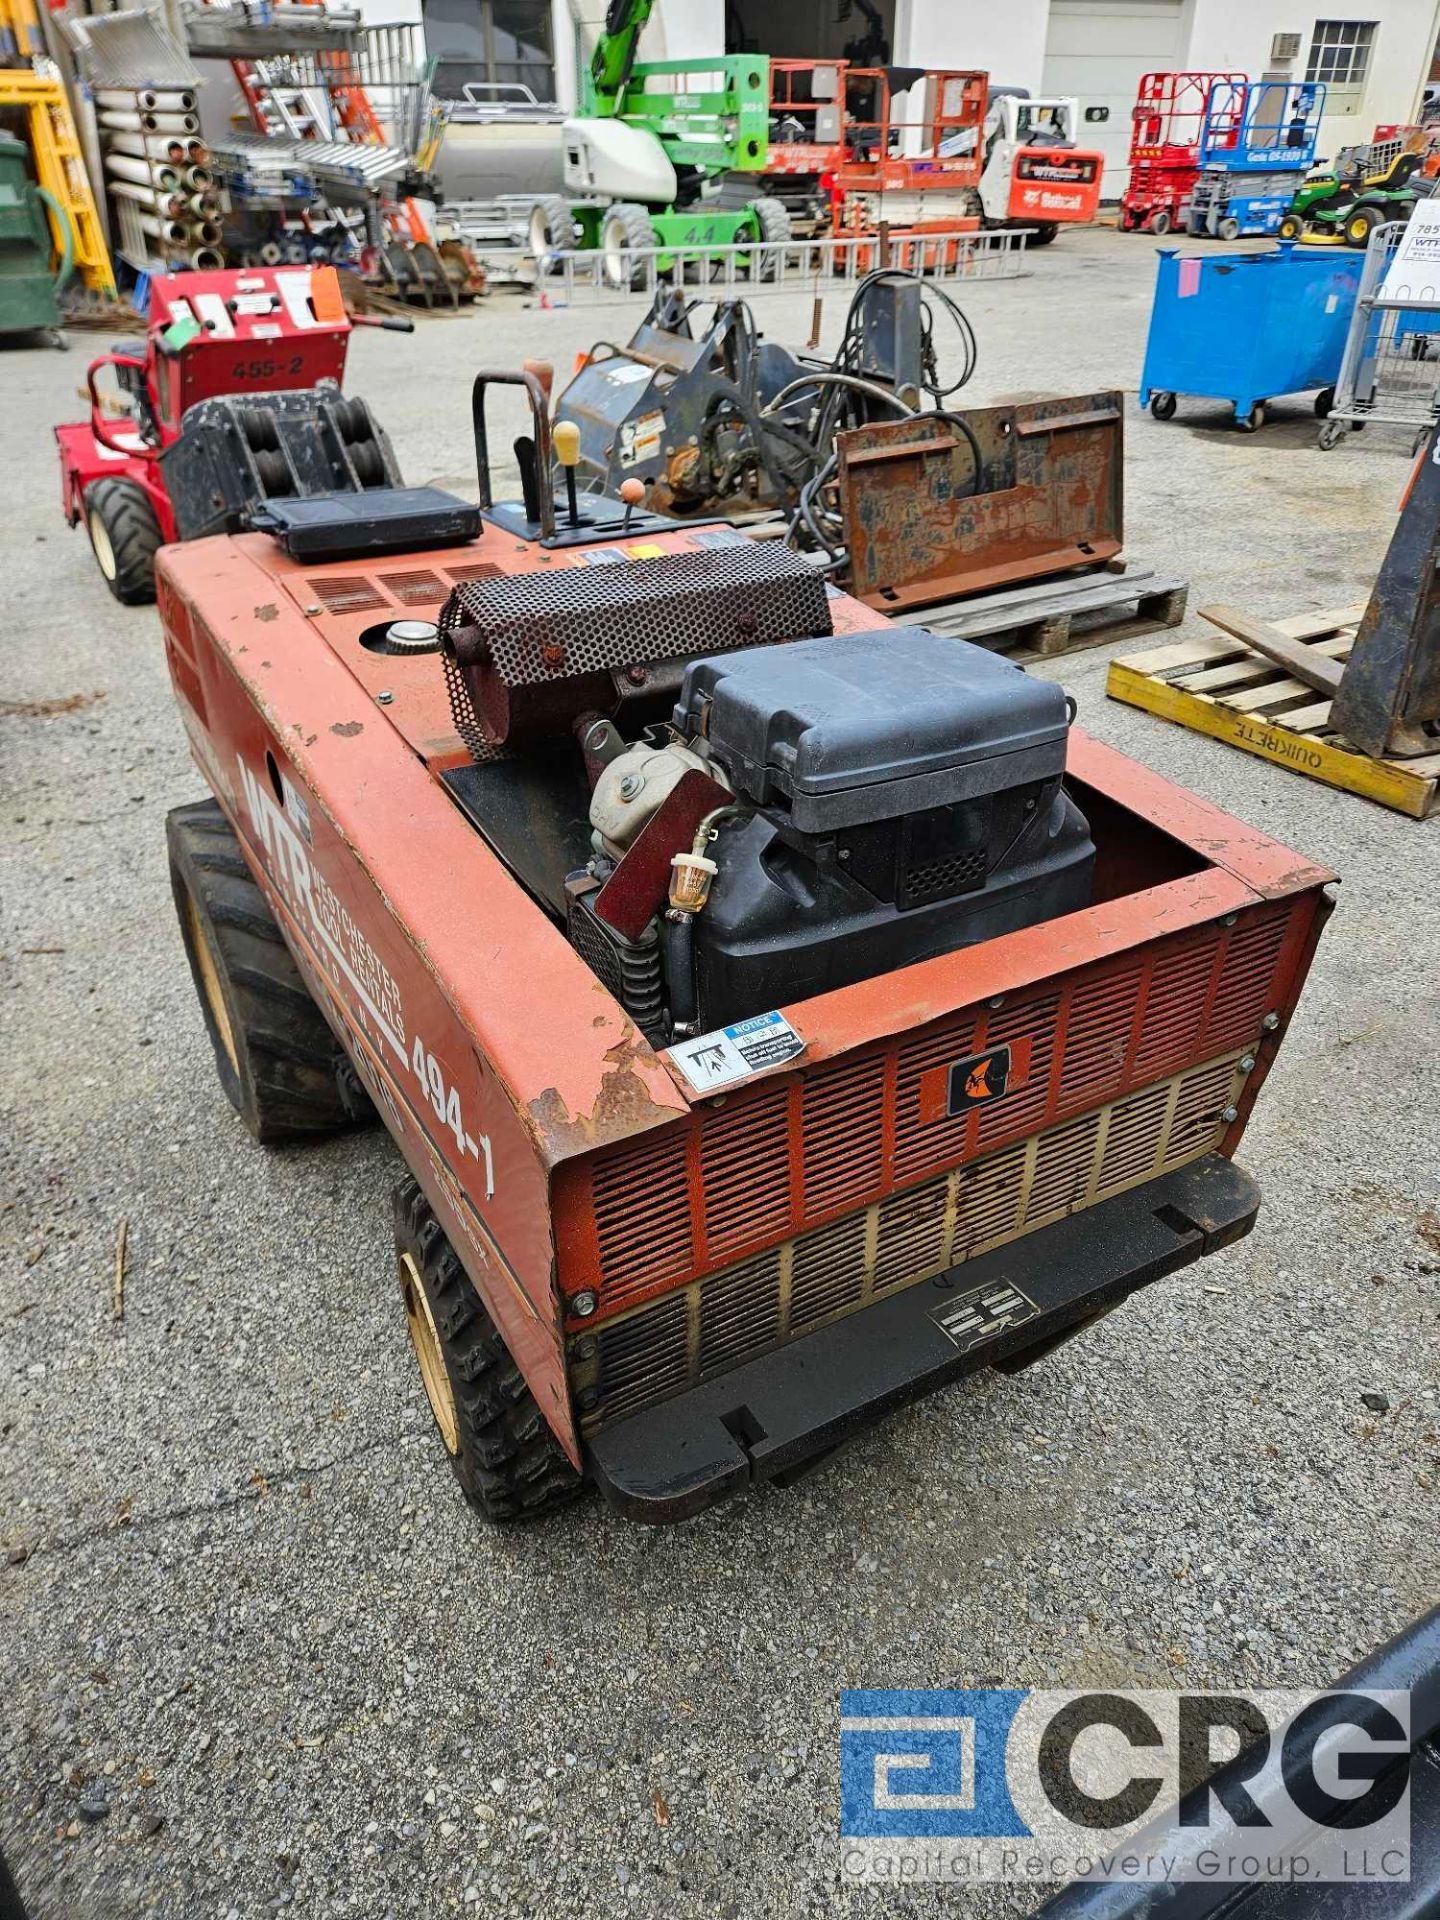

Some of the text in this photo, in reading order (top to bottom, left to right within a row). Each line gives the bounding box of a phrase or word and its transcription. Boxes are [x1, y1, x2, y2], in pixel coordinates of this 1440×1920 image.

[232, 356, 304, 380] 455-2
[1233, 722, 1322, 769] QUIKRETE
[237, 752, 317, 922] WTR
[309, 861, 402, 1012] WESTCHESTER
[315, 891, 346, 955] TOOL
[349, 942, 406, 1045] RENTALS
[734, 1016, 773, 1035] NOTICE
[412, 1035, 495, 1201] 494-1
